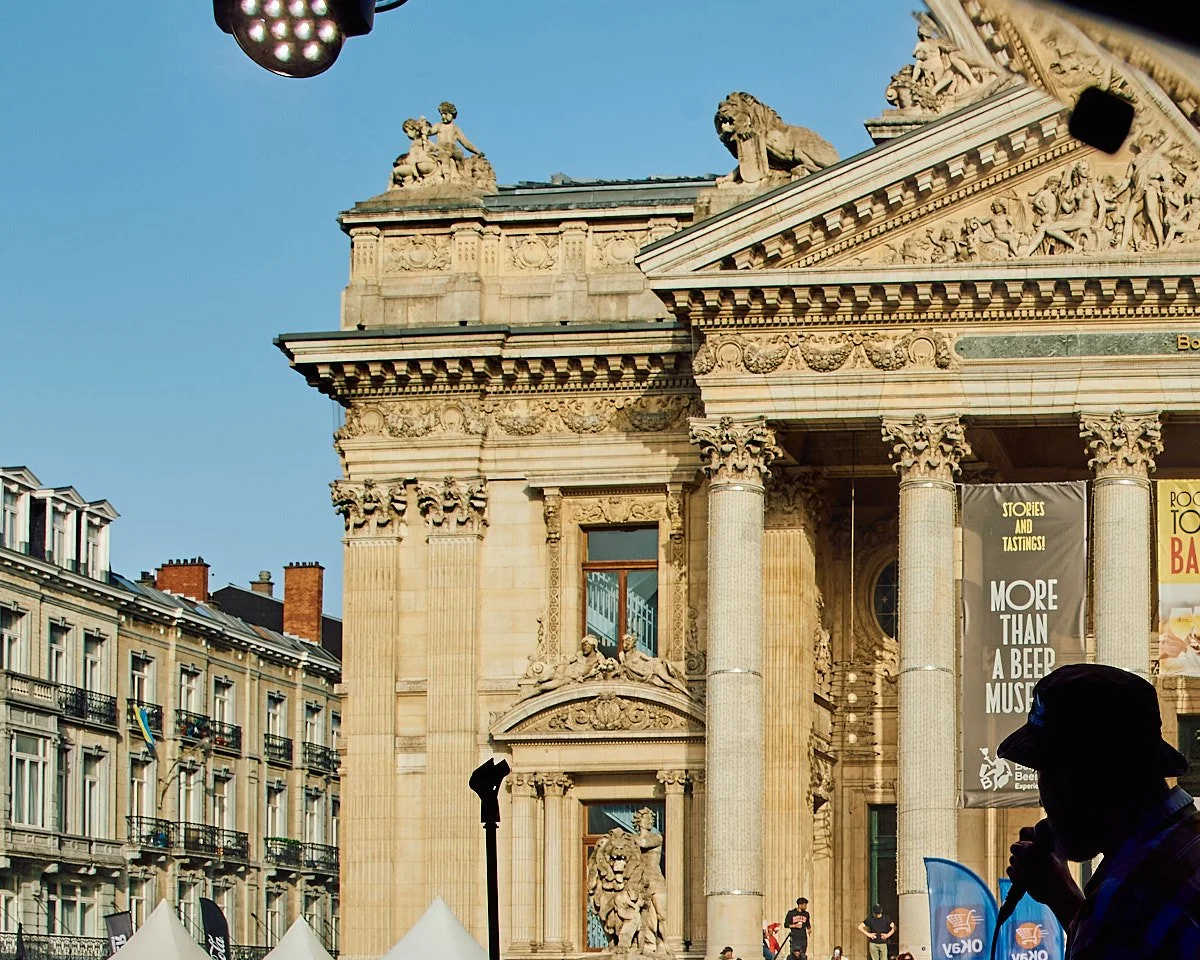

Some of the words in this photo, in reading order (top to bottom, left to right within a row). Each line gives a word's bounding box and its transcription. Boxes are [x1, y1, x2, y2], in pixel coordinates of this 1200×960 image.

[1015, 519, 1033, 534] AND
[990, 579, 1058, 612] MORE
[1000, 613, 1048, 645] THAN
[992, 648, 1005, 680] A
[1010, 647, 1056, 680] BEER
[986, 682, 1037, 714] MUSE
